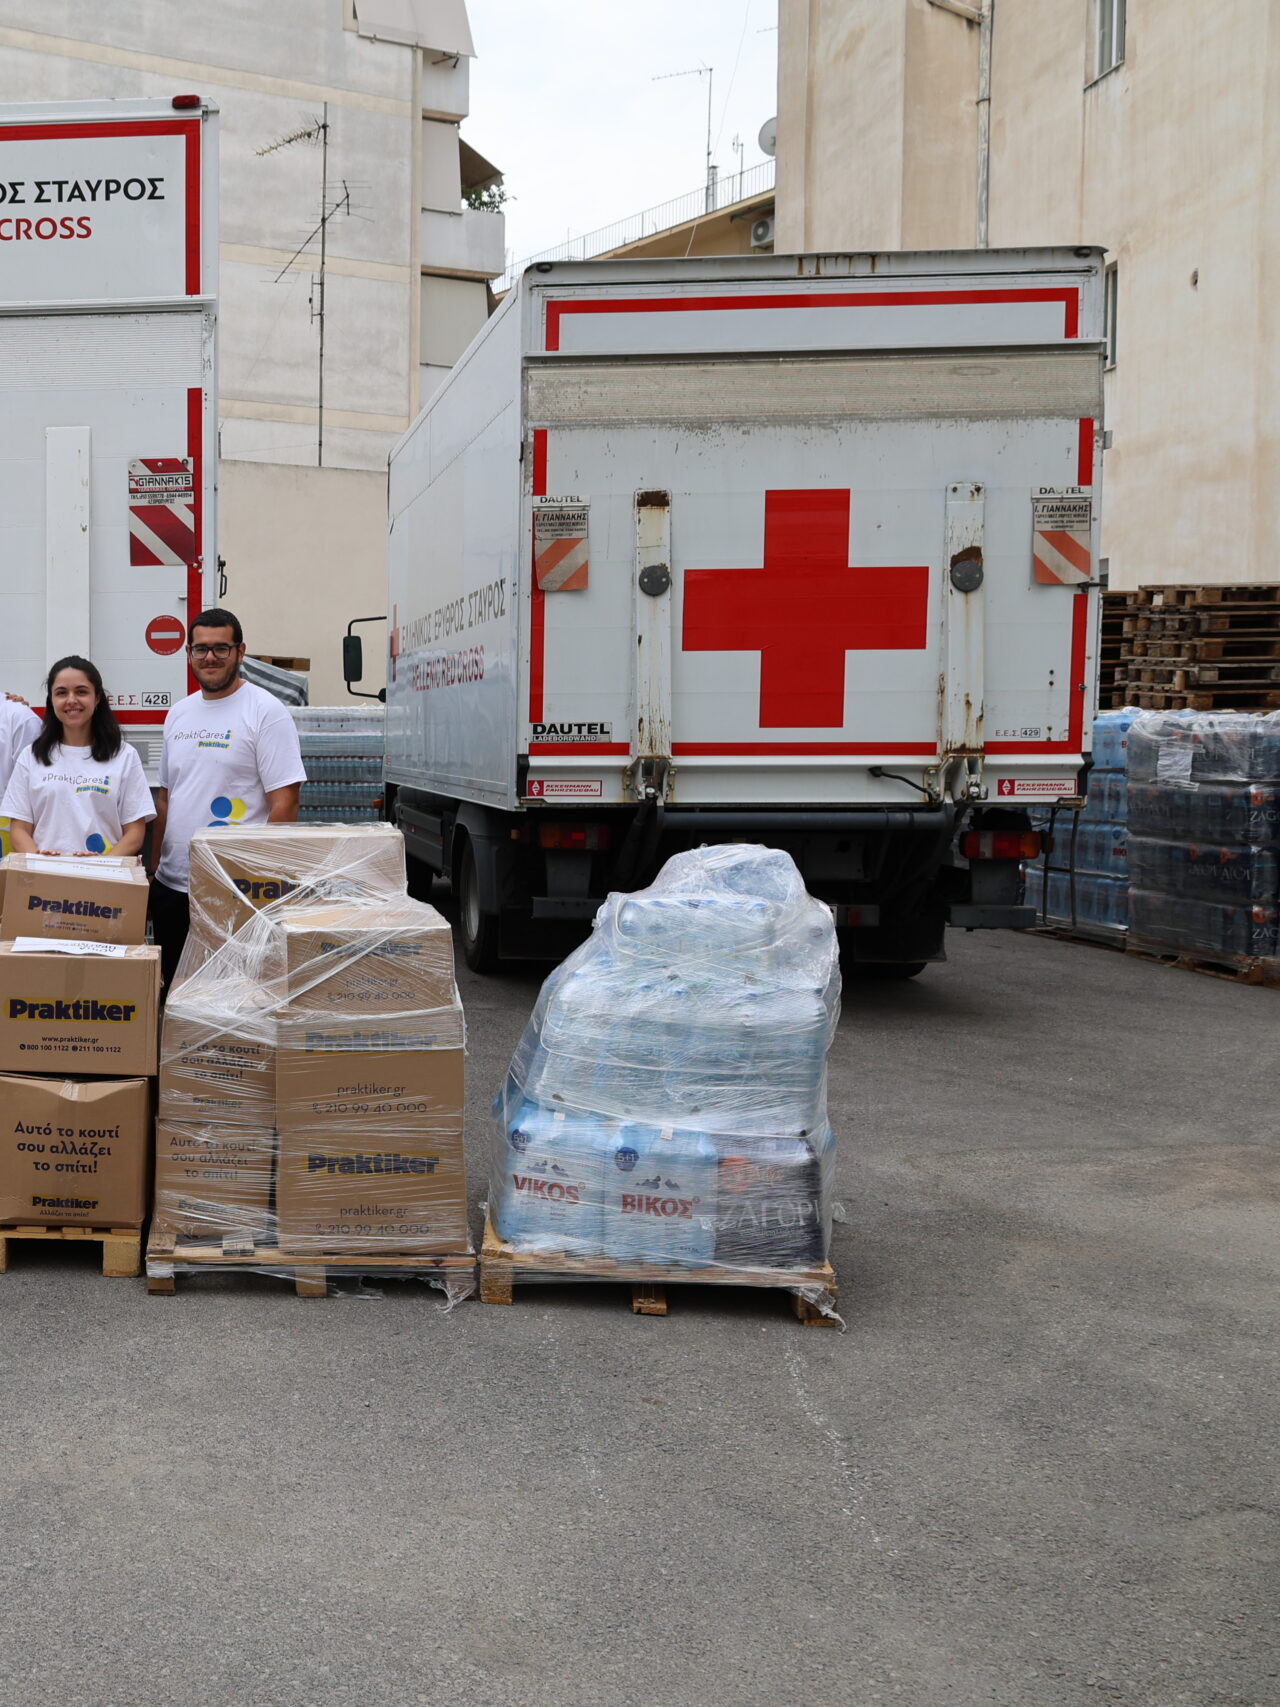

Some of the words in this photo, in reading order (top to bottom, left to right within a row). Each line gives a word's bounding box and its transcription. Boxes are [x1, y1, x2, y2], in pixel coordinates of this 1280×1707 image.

[34, 177, 165, 204] ΣΤΑΥΡΟΣ
[138, 476, 191, 487] GIANNAKIS
[1041, 505, 1089, 513] ΓΙΑΝΝΑΚΗΣ
[542, 512, 587, 521] ΓΙΑΝΝΑΚΗΣ
[434, 597, 465, 641] ΕΡΥΘΡΟΣ
[468, 577, 506, 628] ΣΤΑΥΡΟΣ
[458, 644, 485, 684] CROSS
[144, 694, 169, 705] 428
[532, 723, 610, 735] DAUTEL
[27, 895, 123, 920] Praktiker
[9, 998, 136, 1022] Praktiker
[41, 1036, 99, 1044] www.praktiker.gr
[229, 1043, 261, 1055] κουτί
[337, 1083, 406, 1096] praktiker.gr
[325, 1103, 348, 1113] 210
[352, 1103, 369, 1112] 99
[373, 1103, 392, 1113] 40
[396, 1103, 428, 1113] 000
[14, 1121, 52, 1136] Αυτό
[56, 1127, 74, 1137] το
[79, 1124, 119, 1138] κουτί
[17, 1142, 44, 1153] σου
[50, 1141, 111, 1158] αλλάζει
[171, 1152, 195, 1162] σου
[33, 1160, 50, 1171] το
[55, 1161, 98, 1173] σπίτι!
[307, 1153, 440, 1175] Praktiker
[513, 1174, 580, 1204] VIKOS
[32, 1196, 98, 1209] Praktiker
[621, 1193, 693, 1219] ΒΙΚΟΣ
[340, 1205, 408, 1218] praktiker.gr
[328, 1225, 351, 1235] 210
